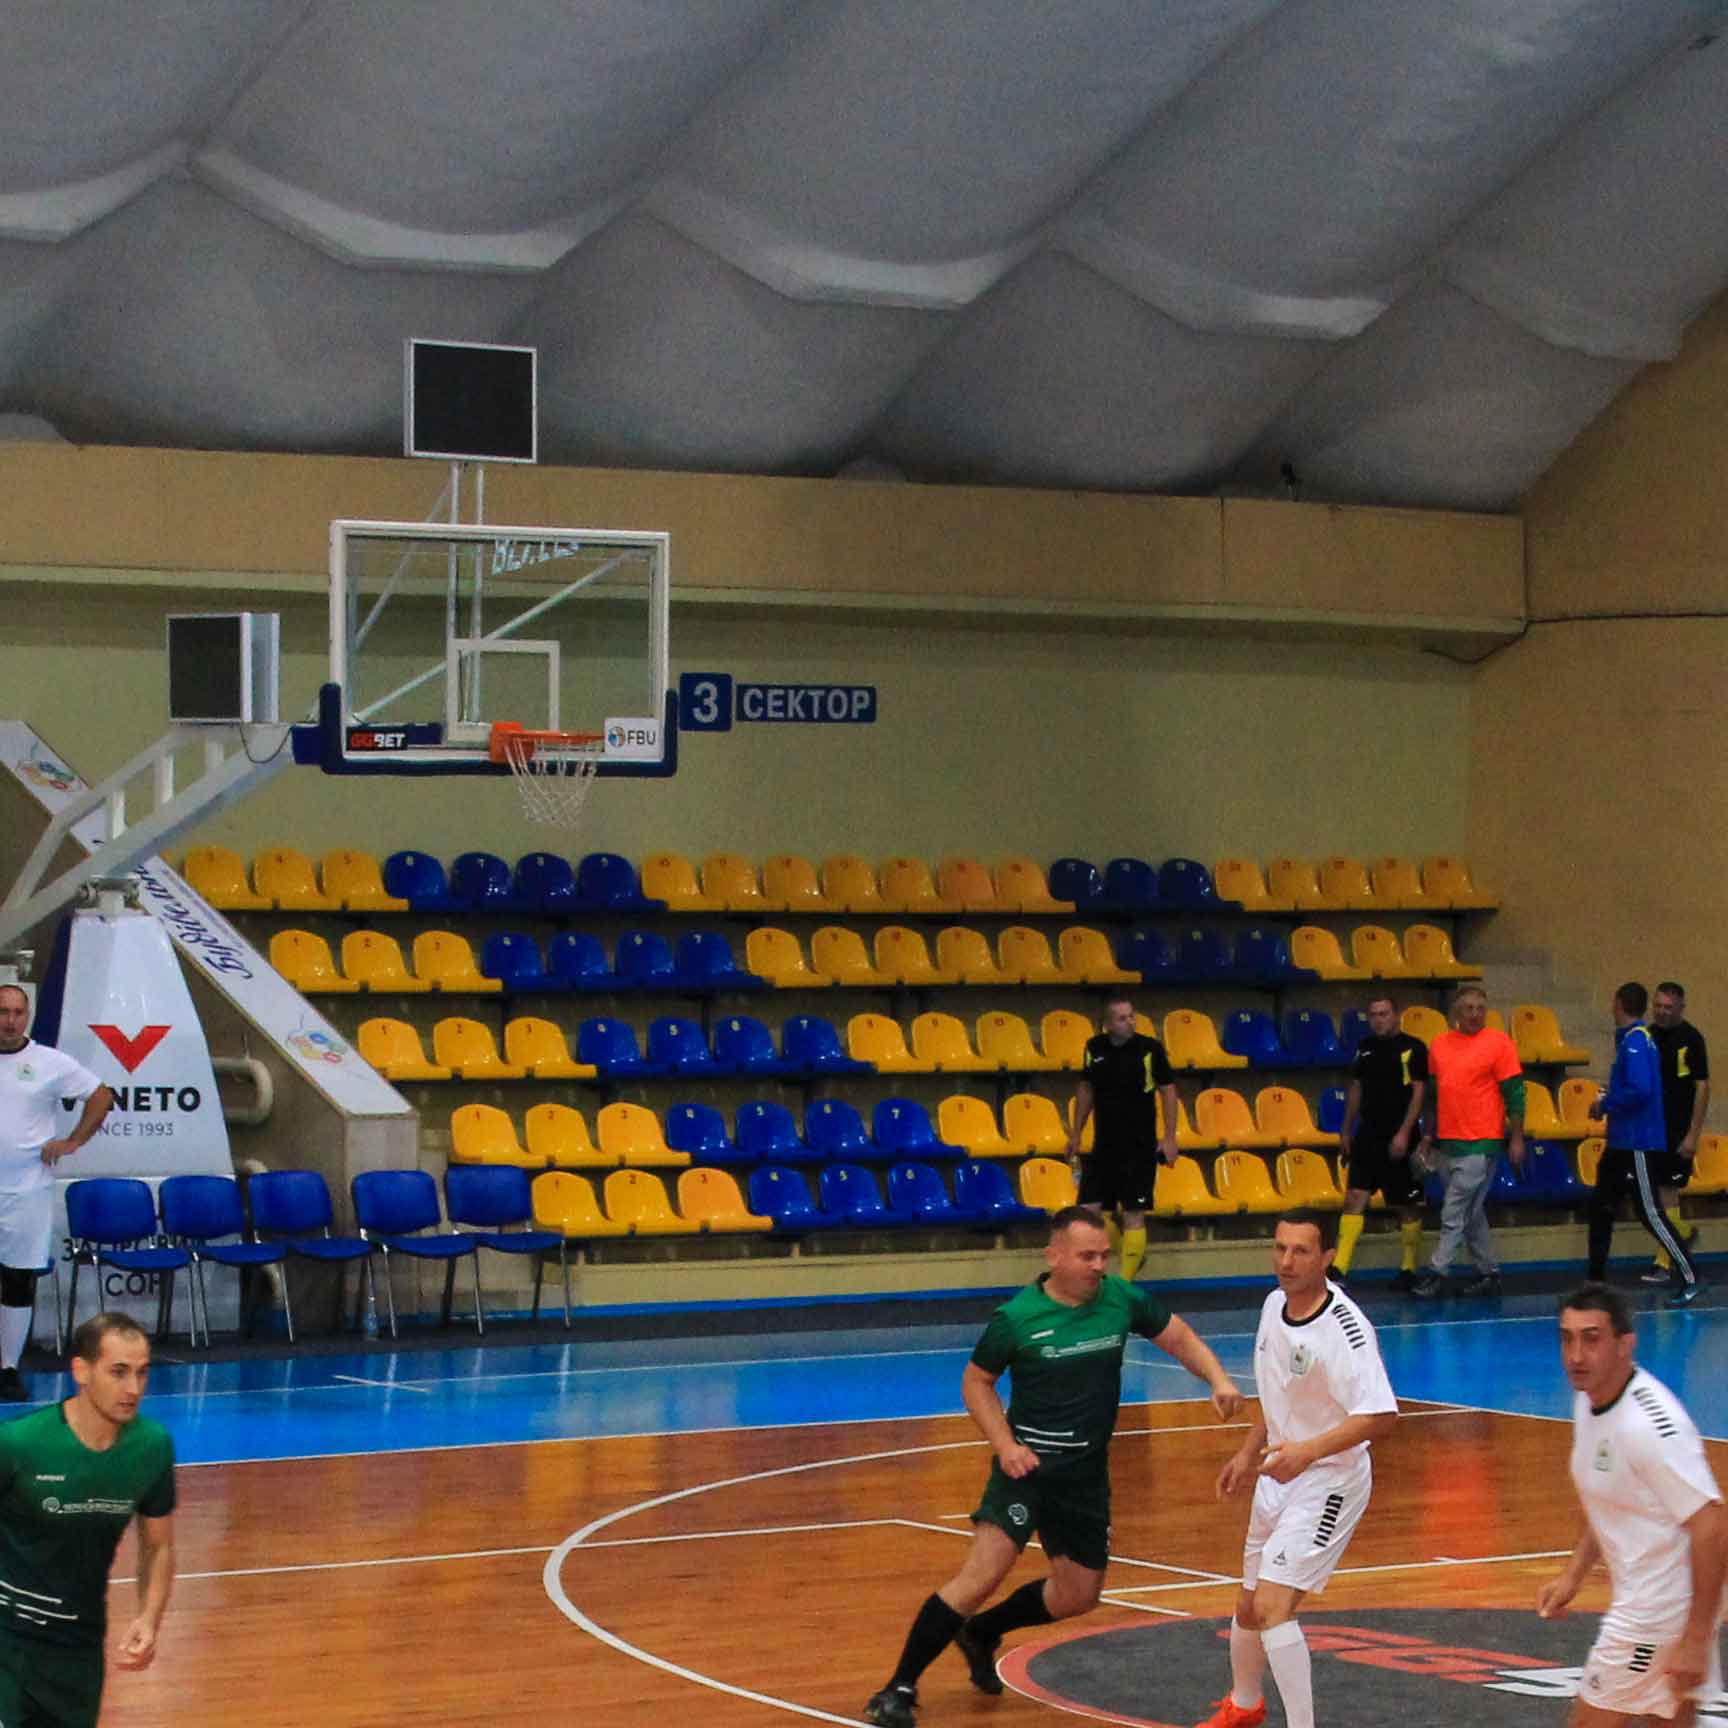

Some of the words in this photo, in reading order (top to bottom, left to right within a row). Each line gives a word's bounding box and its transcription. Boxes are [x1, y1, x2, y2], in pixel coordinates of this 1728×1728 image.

[692, 682, 718, 723] 3
[742, 688, 871, 721] СЕКТОР
[627, 730, 656, 746] FBU
[61, 1086, 201, 1112] VNETO
[138, 1122, 175, 1137] 1993
